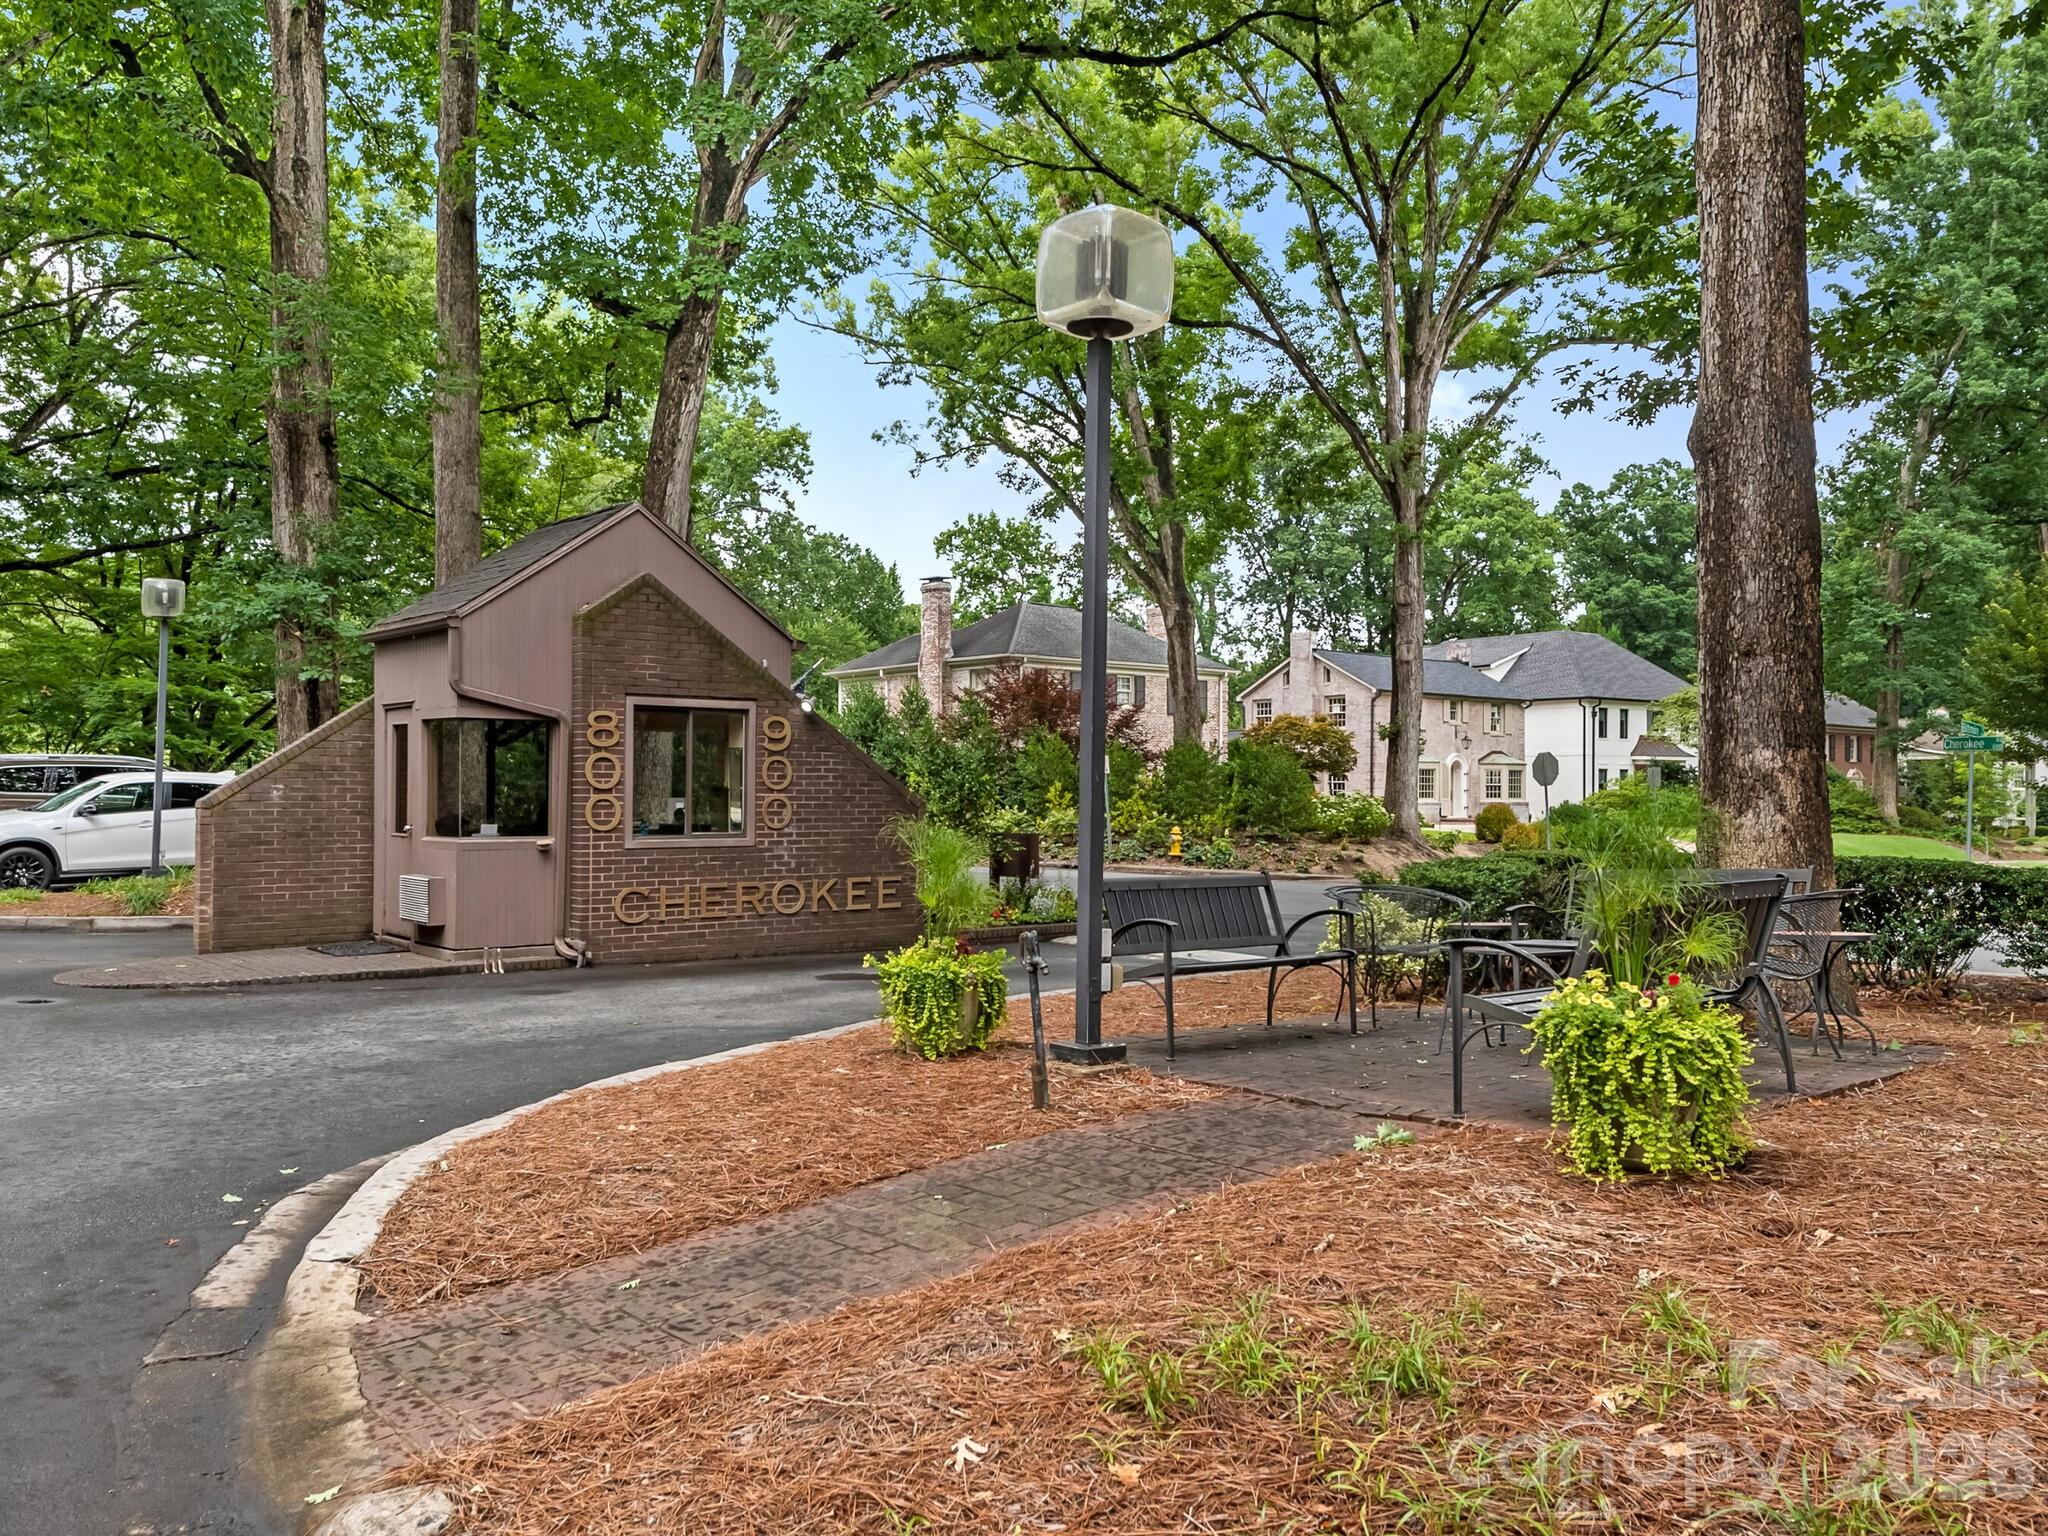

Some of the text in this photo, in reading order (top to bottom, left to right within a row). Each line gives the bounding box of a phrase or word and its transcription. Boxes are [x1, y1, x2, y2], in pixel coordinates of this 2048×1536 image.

[585, 710, 621, 831] 800
[762, 715, 792, 829] 900
[1944, 739, 1984, 749] Cherokee
[614, 876, 902, 924] CHEROKEE
